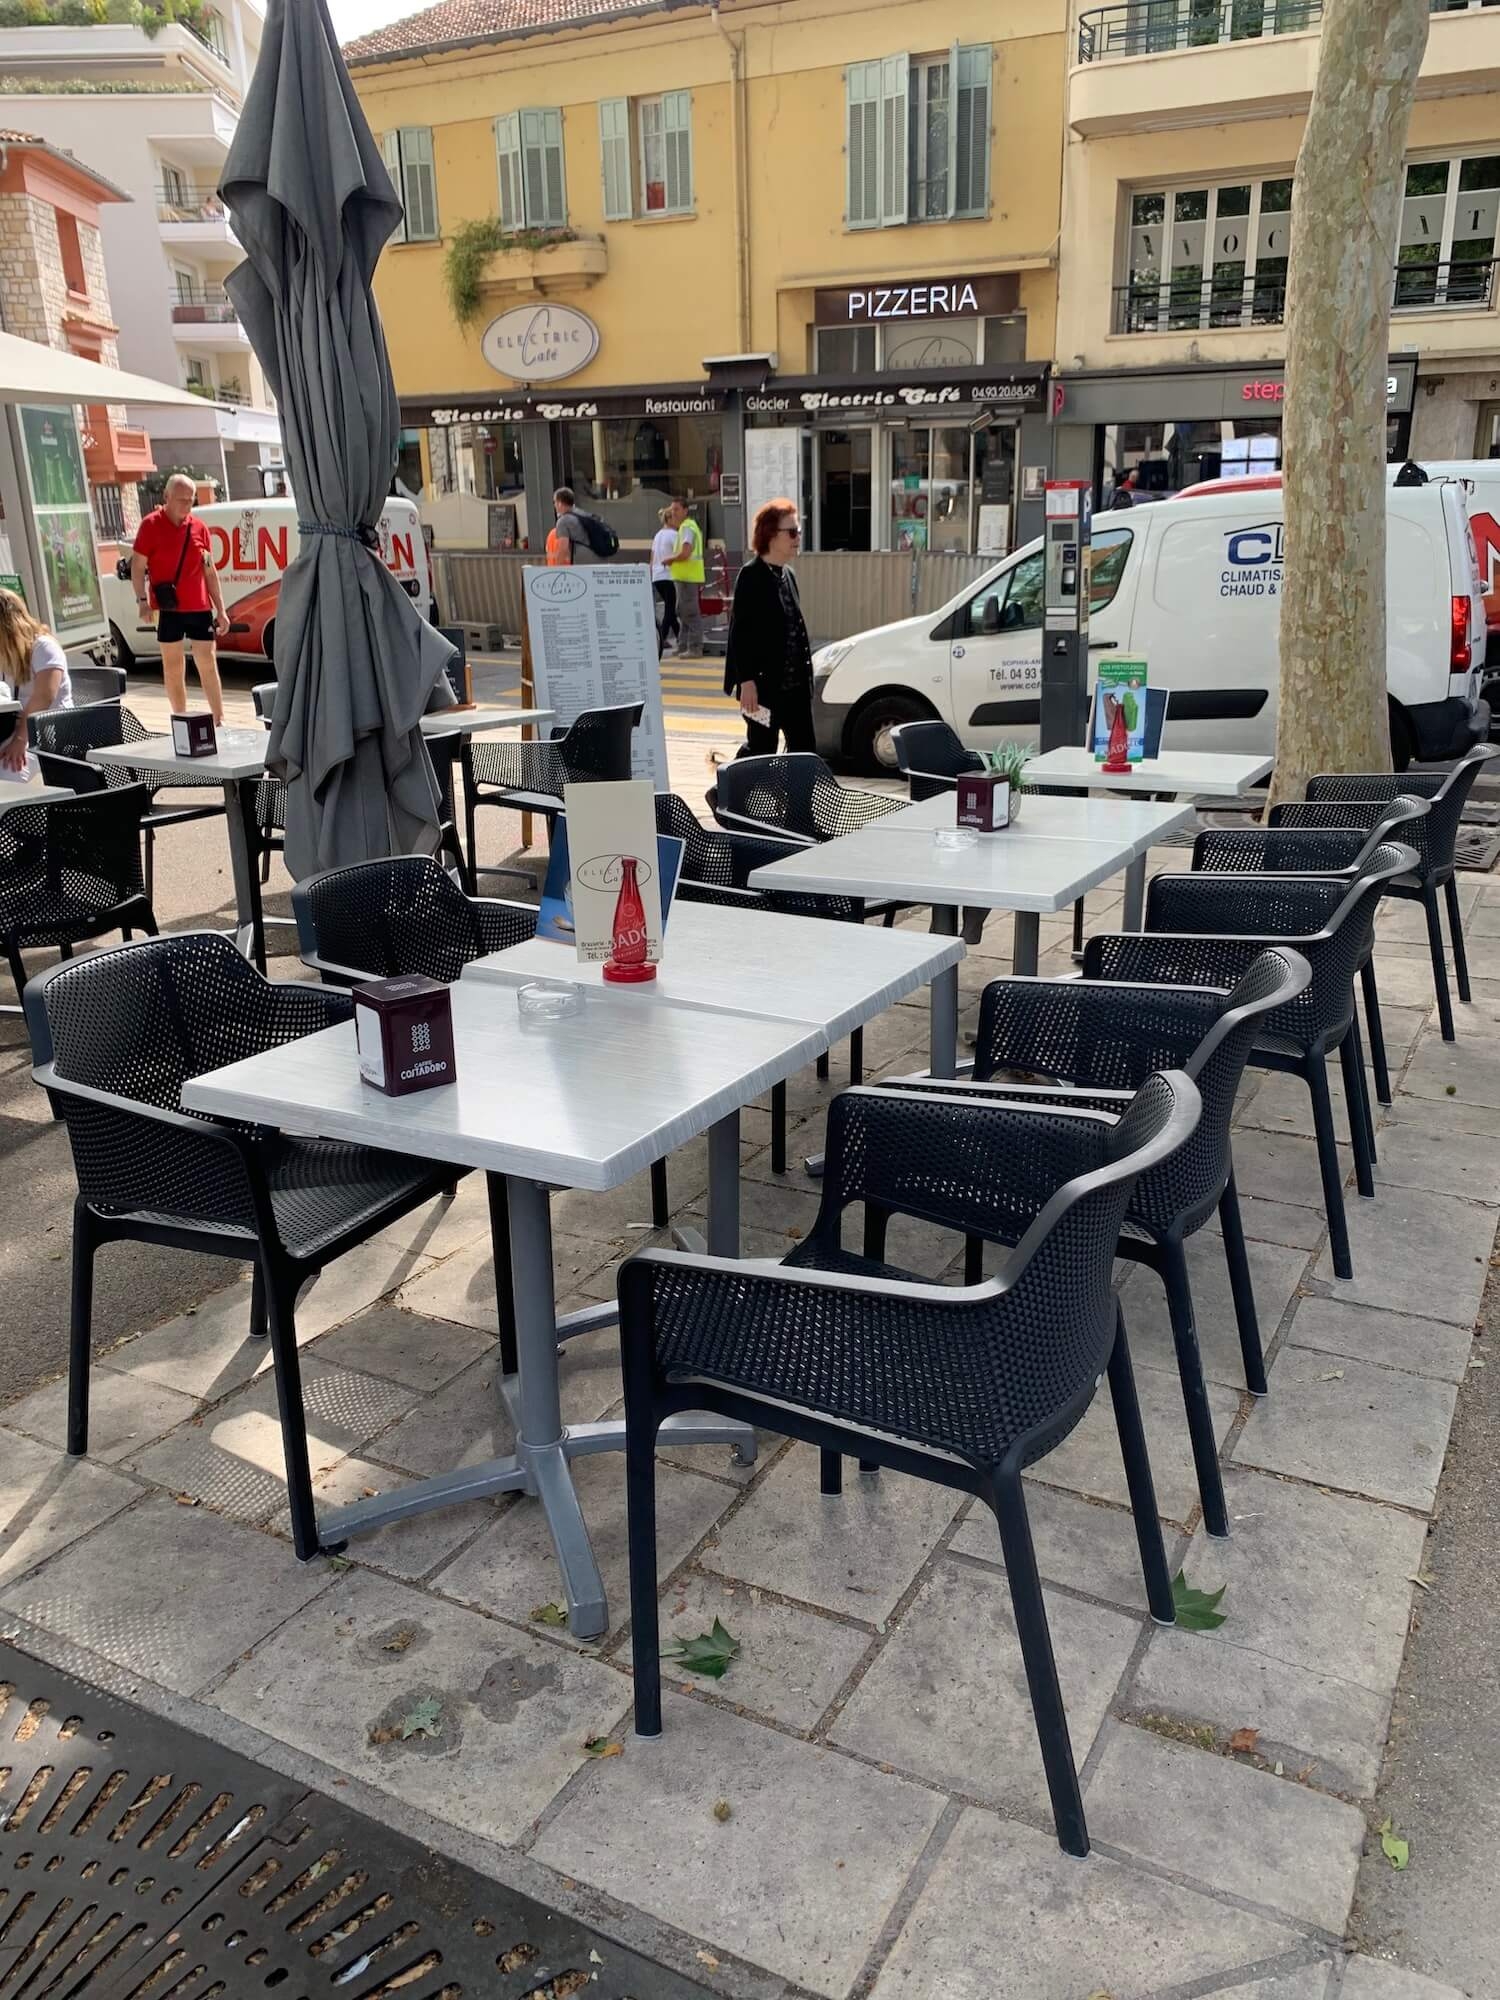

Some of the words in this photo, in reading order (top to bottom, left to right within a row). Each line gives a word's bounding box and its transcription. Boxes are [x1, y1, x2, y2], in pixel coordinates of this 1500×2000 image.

[848, 283, 979, 320] PIZZERIA
[497, 330, 579, 348] ELECTRIC
[522, 308, 558, 367] Café
[746, 396, 790, 410] Glacier
[800, 391, 895, 410] Electric
[899, 387, 961, 405] Café
[431, 408, 524, 425] Electric
[536, 402, 598, 419] Café
[645, 398, 715, 413] Restaurant
[1221, 569, 1283, 583] CLIMATIS
[1220, 583, 1264, 596] CHAUD
[1268, 583, 1277, 595] &
[1010, 668, 1021, 680] 04
[1024, 667, 1037, 679] 93
